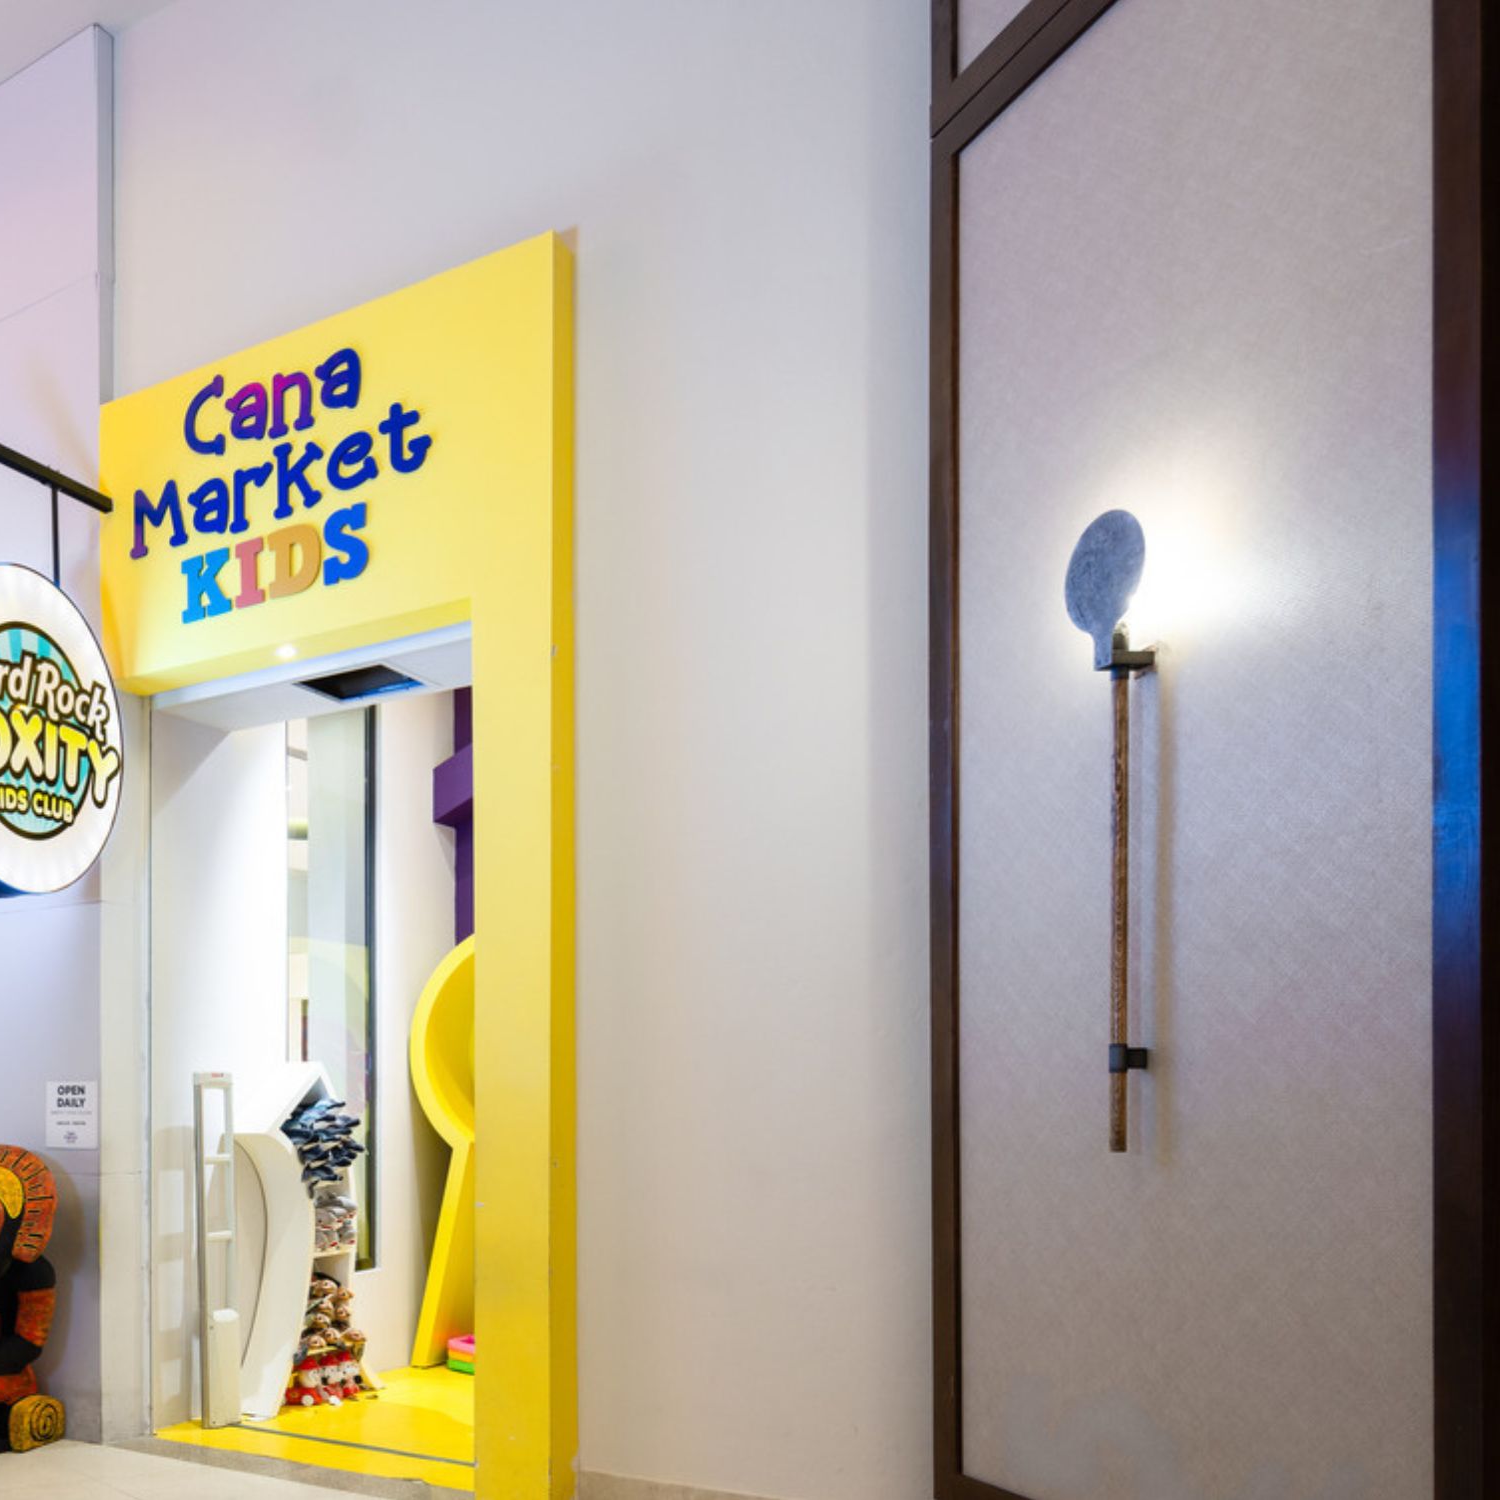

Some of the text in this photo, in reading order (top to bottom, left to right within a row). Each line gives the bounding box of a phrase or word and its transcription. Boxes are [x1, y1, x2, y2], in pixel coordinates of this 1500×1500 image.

[184, 348, 361, 455] Cana
[130, 402, 432, 559] Market
[181, 503, 370, 624] KIDS
[35, 660, 109, 743] Rock
[32, 790, 74, 824] CLUB
[57, 1085, 85, 1095] OPEN
[57, 1098, 86, 1108] DAILY
